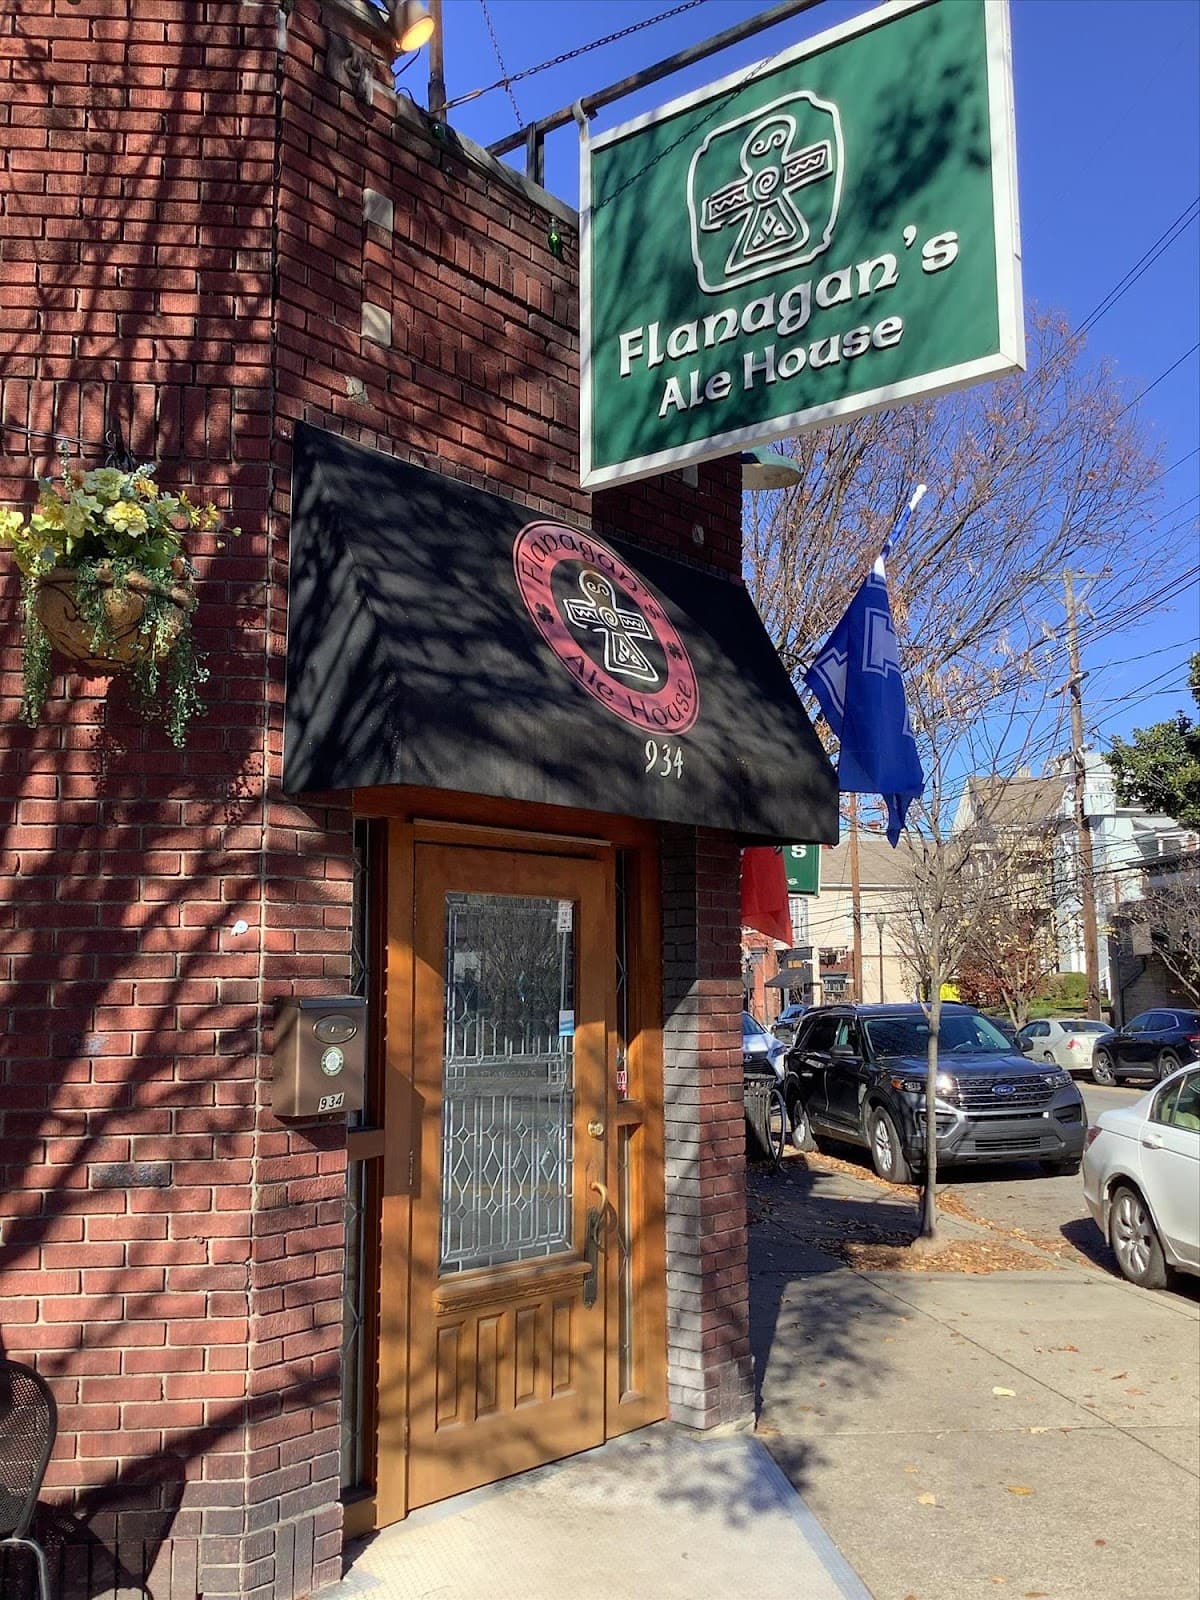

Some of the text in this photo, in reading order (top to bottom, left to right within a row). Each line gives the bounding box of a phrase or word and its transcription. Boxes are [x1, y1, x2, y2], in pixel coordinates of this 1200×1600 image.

[618, 225, 960, 377] Flanagan's
[657, 315, 904, 418] Ale House
[521, 533, 661, 620] Flanagan's
[566, 655, 692, 726] Ale House
[643, 740, 684, 779] 934
[320, 1095, 343, 1110] 934
